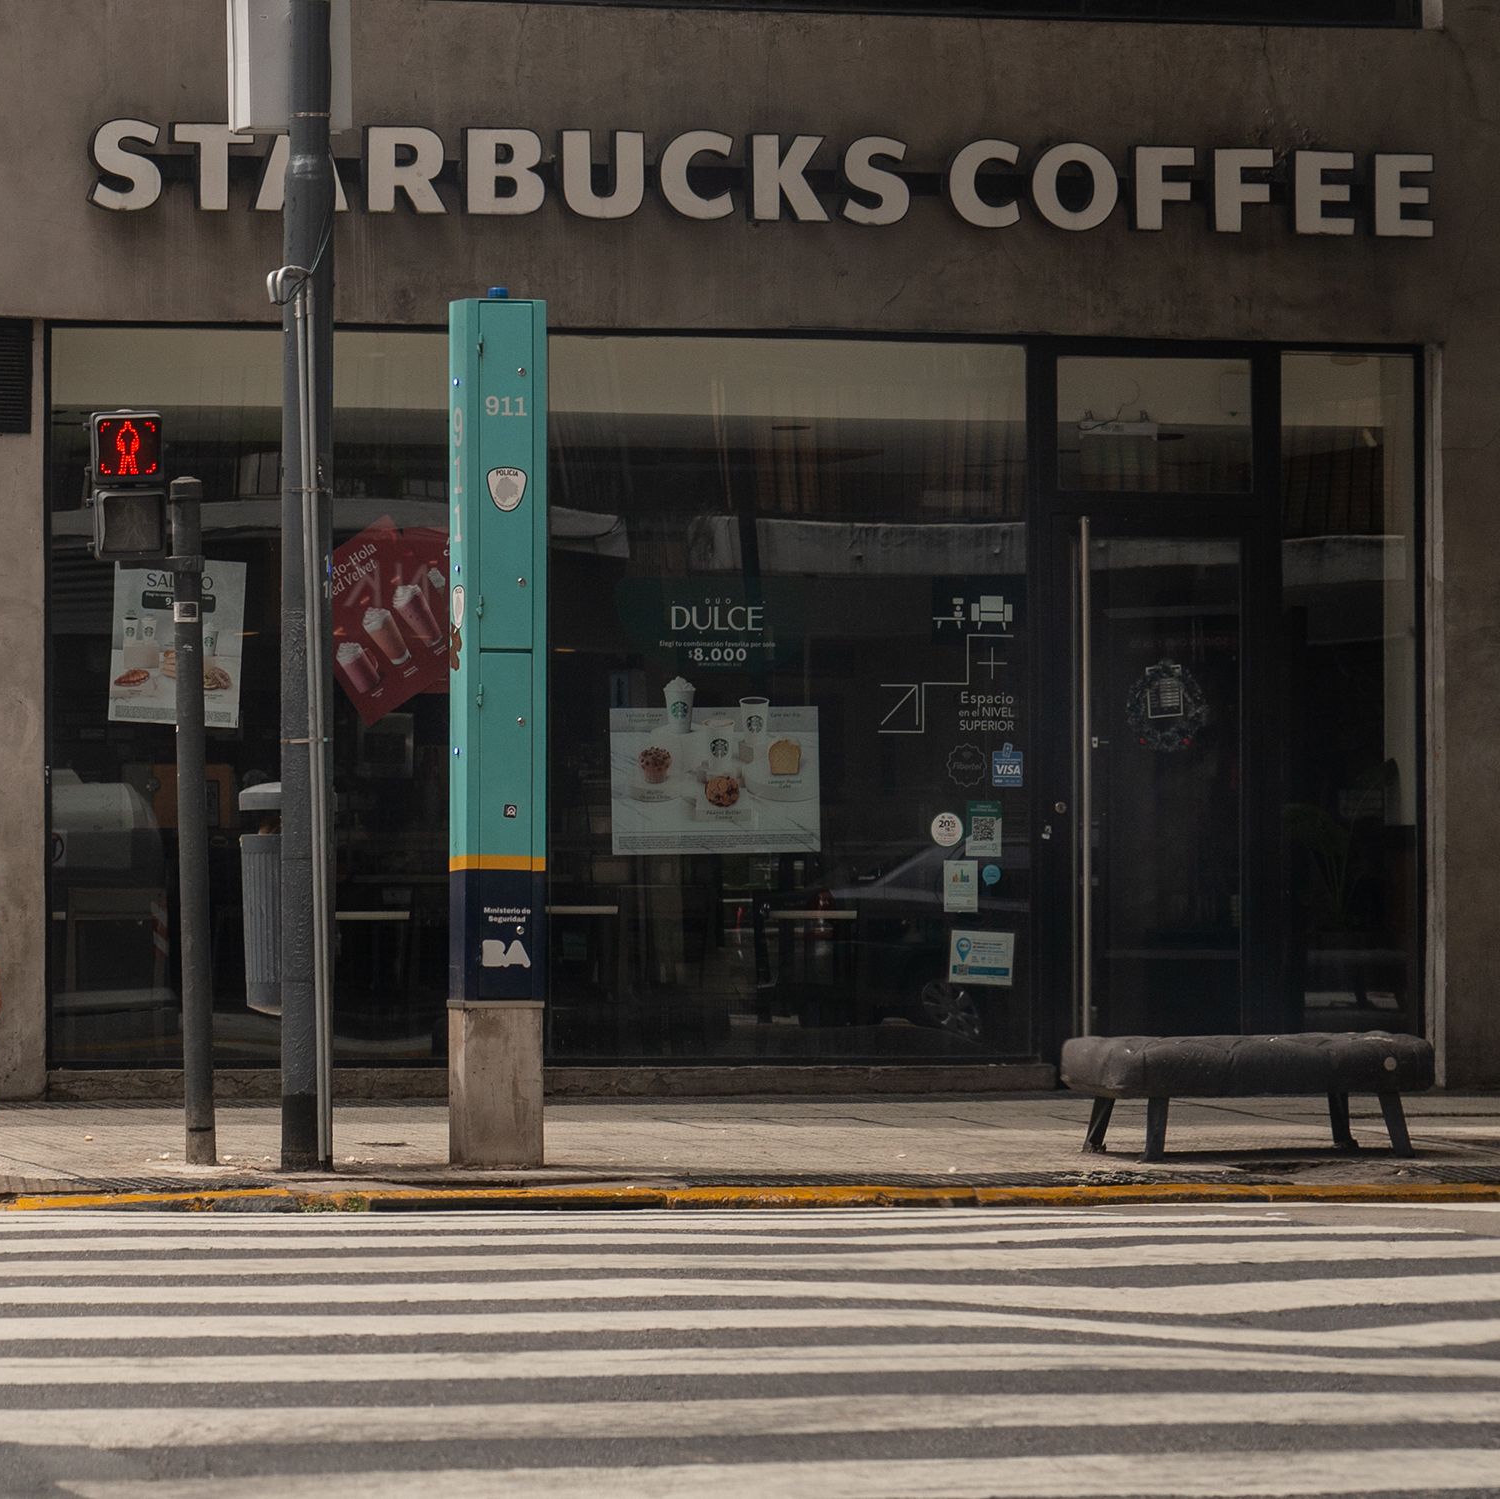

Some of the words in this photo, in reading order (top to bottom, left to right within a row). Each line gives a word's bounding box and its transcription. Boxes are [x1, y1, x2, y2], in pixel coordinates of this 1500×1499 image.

[948, 139, 1435, 240] COFFEE
[485, 396, 528, 416] 911
[344, 558, 377, 586] Velvet
[671, 605, 763, 631] DULCE
[688, 648, 747, 661] $8.000
[960, 690, 1014, 708] Espacio
[958, 709, 970, 717] en
[971, 707, 980, 717] el
[982, 707, 1015, 718] NIVEL
[959, 720, 1015, 732] SUPERIOR
[952, 761, 983, 771] Fibertel
[995, 764, 1021, 775] VISA
[483, 906, 521, 914] Ministerio
[521, 906, 531, 914] de
[488, 915, 526, 924] Seguridad
[482, 939, 531, 968] BA
